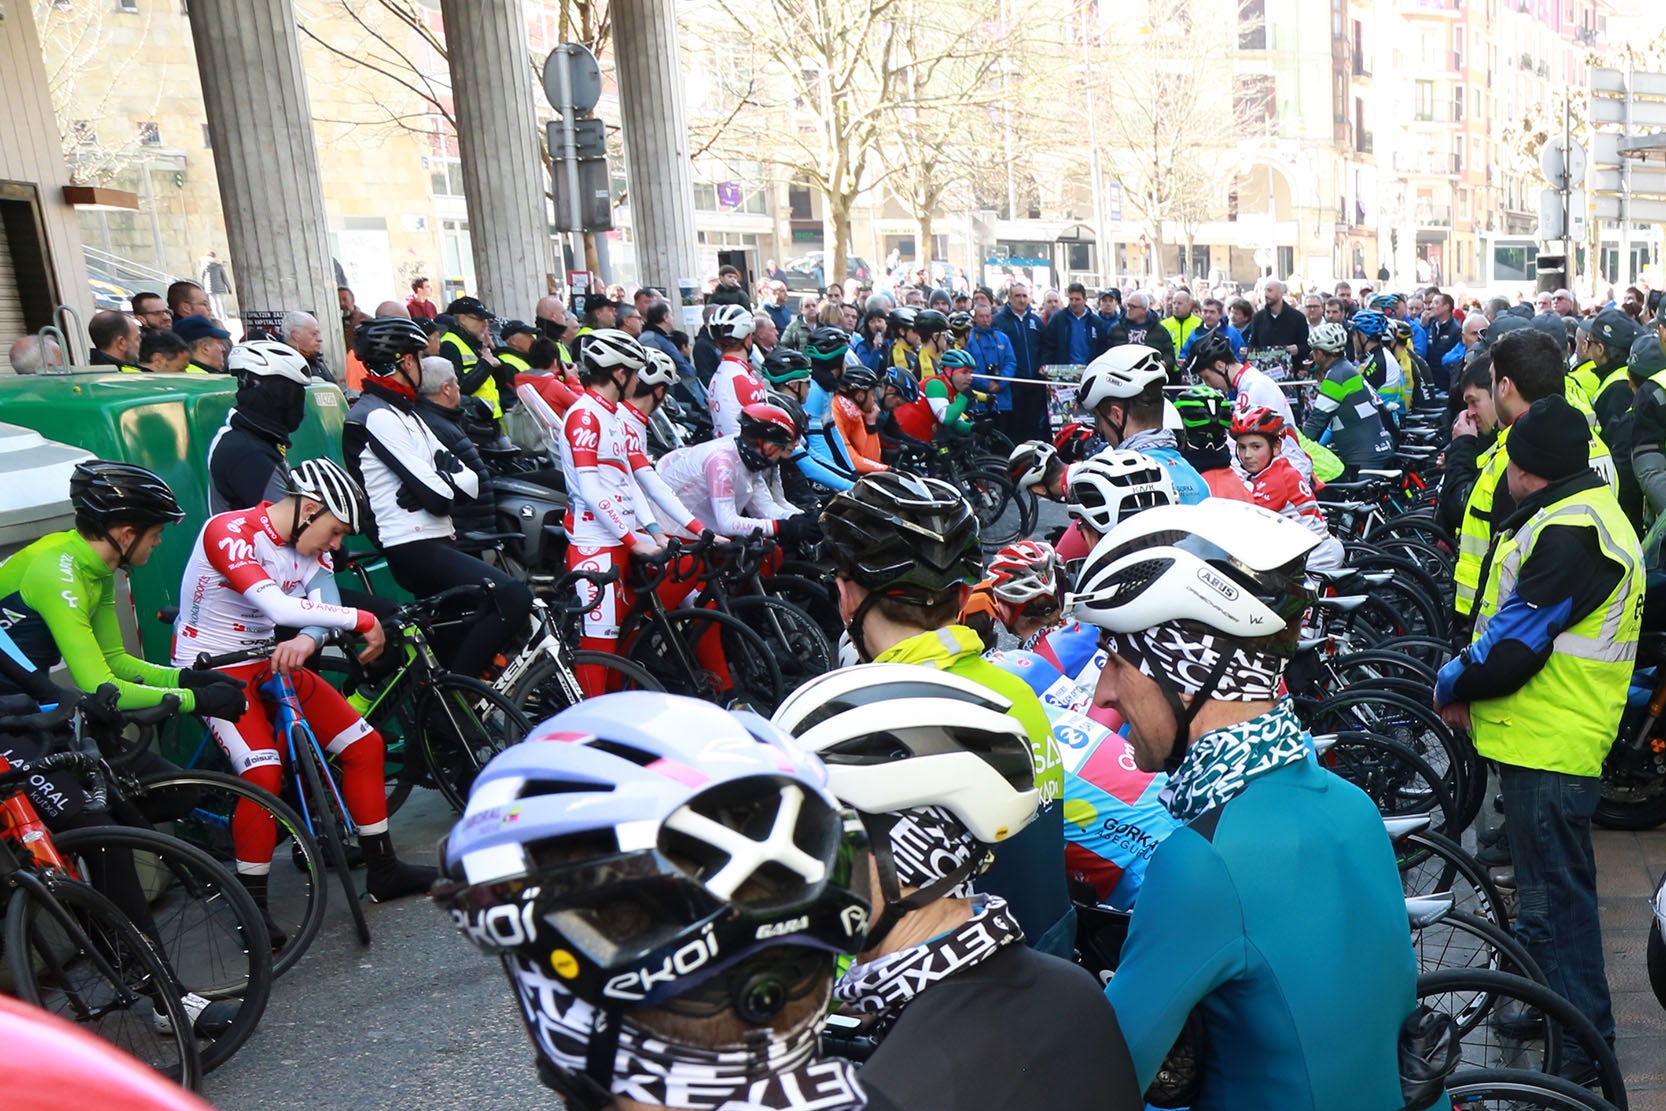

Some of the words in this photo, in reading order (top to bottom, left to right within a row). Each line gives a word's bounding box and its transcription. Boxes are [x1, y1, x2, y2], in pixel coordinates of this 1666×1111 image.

[1132, 485, 1156, 494] KASK
[1201, 572, 1234, 598] ABUS
[317, 604, 351, 616] AMPO
[3, 749, 69, 811] LAORAL
[30, 790, 58, 817] kutxa
[1104, 817, 1159, 851] GORKA
